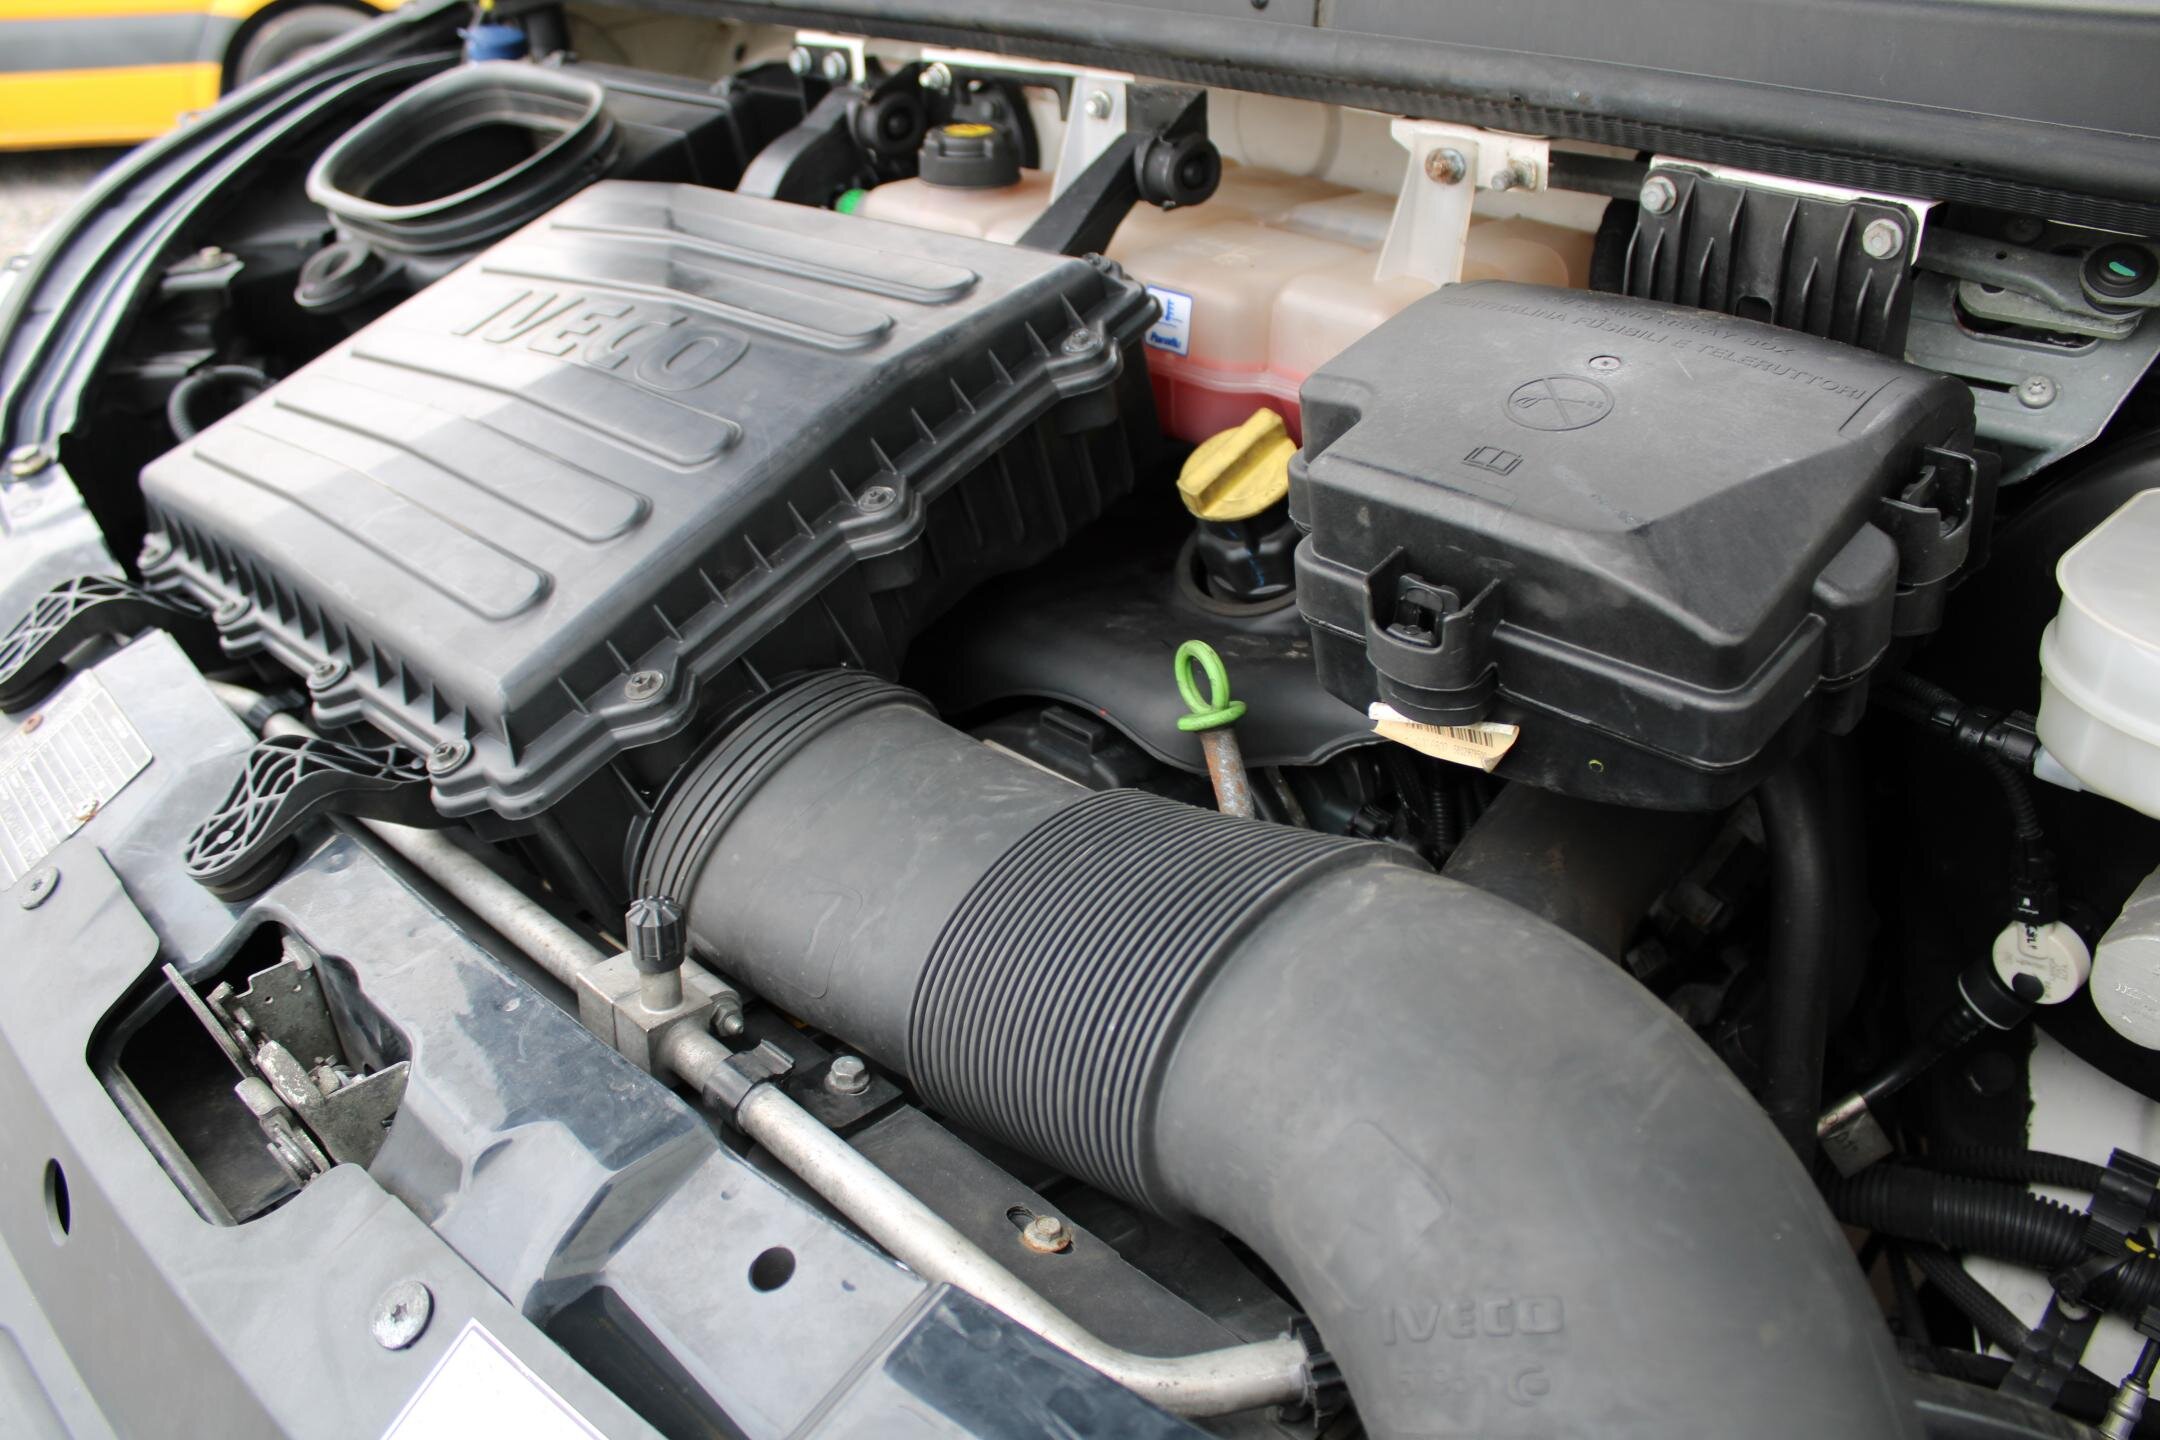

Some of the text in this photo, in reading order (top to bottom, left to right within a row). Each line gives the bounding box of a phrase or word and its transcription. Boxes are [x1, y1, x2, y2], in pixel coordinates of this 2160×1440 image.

[450, 288, 753, 393] IVECO
[1572, 315, 1670, 344] FUSIBILI
[1670, 338, 1693, 349] E
[1695, 342, 1869, 400] TELERUTTORI
[1382, 1295, 1566, 1347] IVECO
